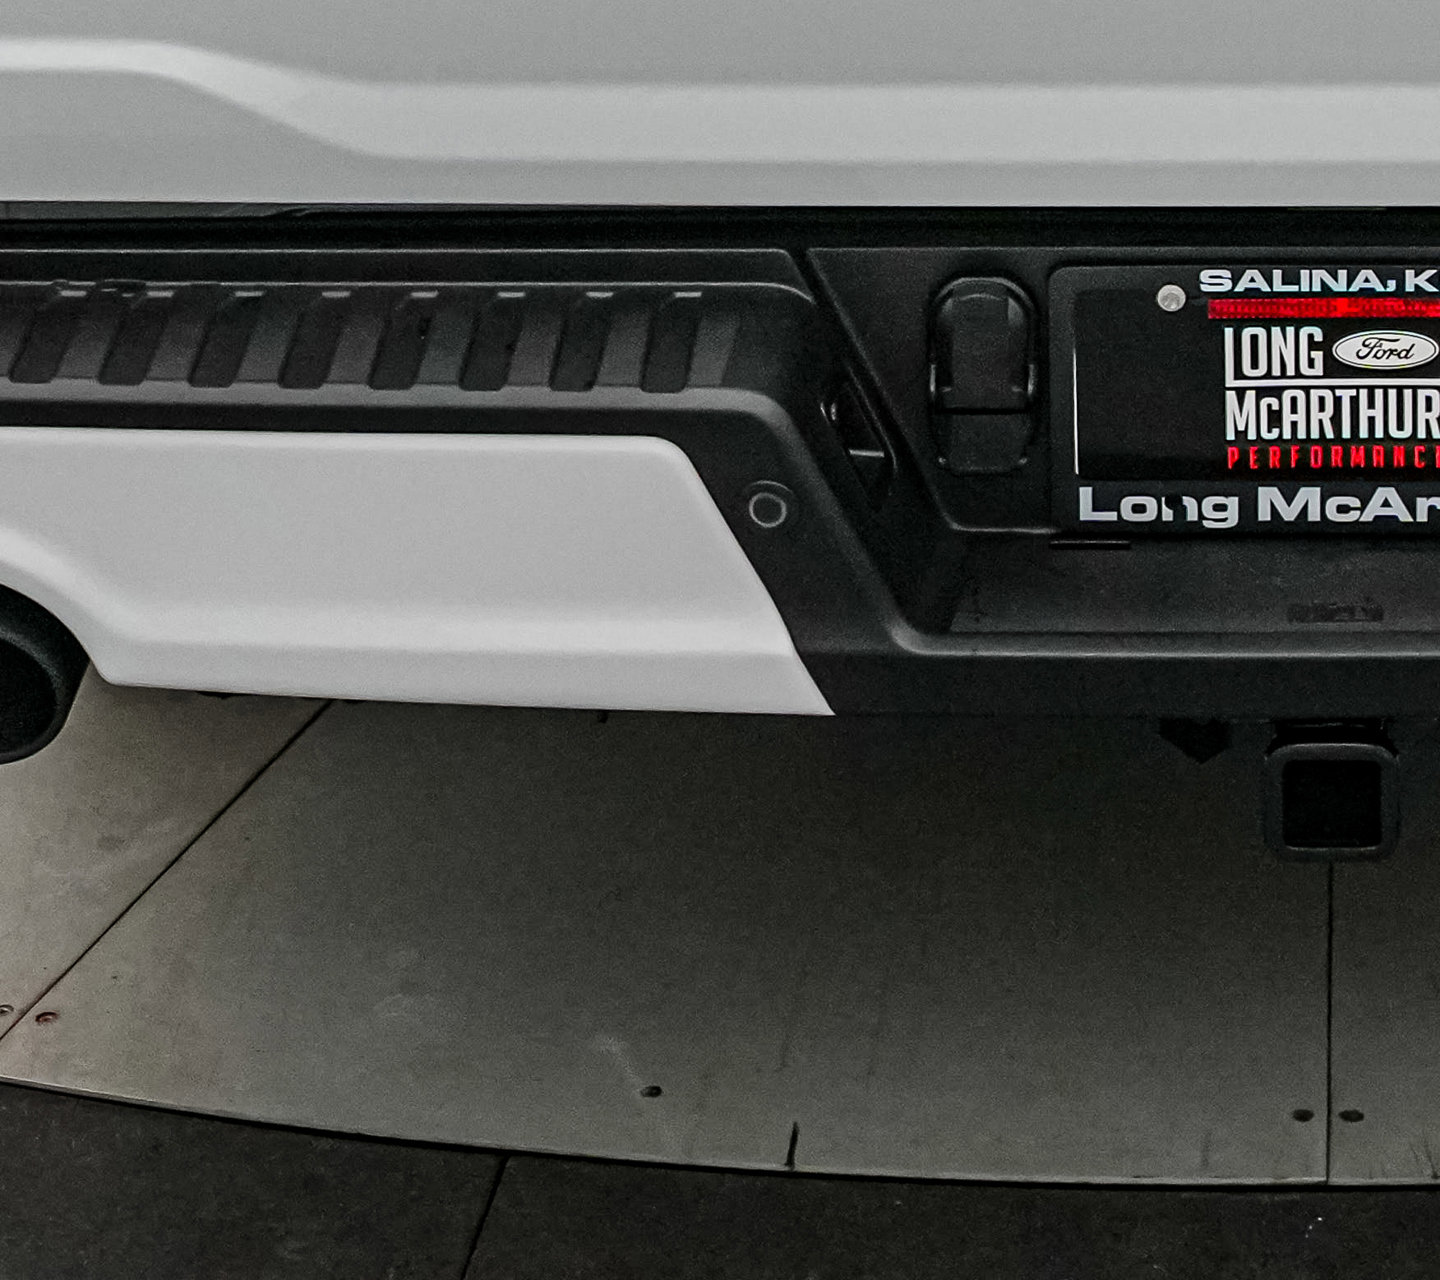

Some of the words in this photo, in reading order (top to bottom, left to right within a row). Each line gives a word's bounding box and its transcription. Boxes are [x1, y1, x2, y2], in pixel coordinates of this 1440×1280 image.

[1199, 268, 1398, 293] SALINA,
[1224, 326, 1324, 386] LONG
[1078, 486, 1240, 529] Long
